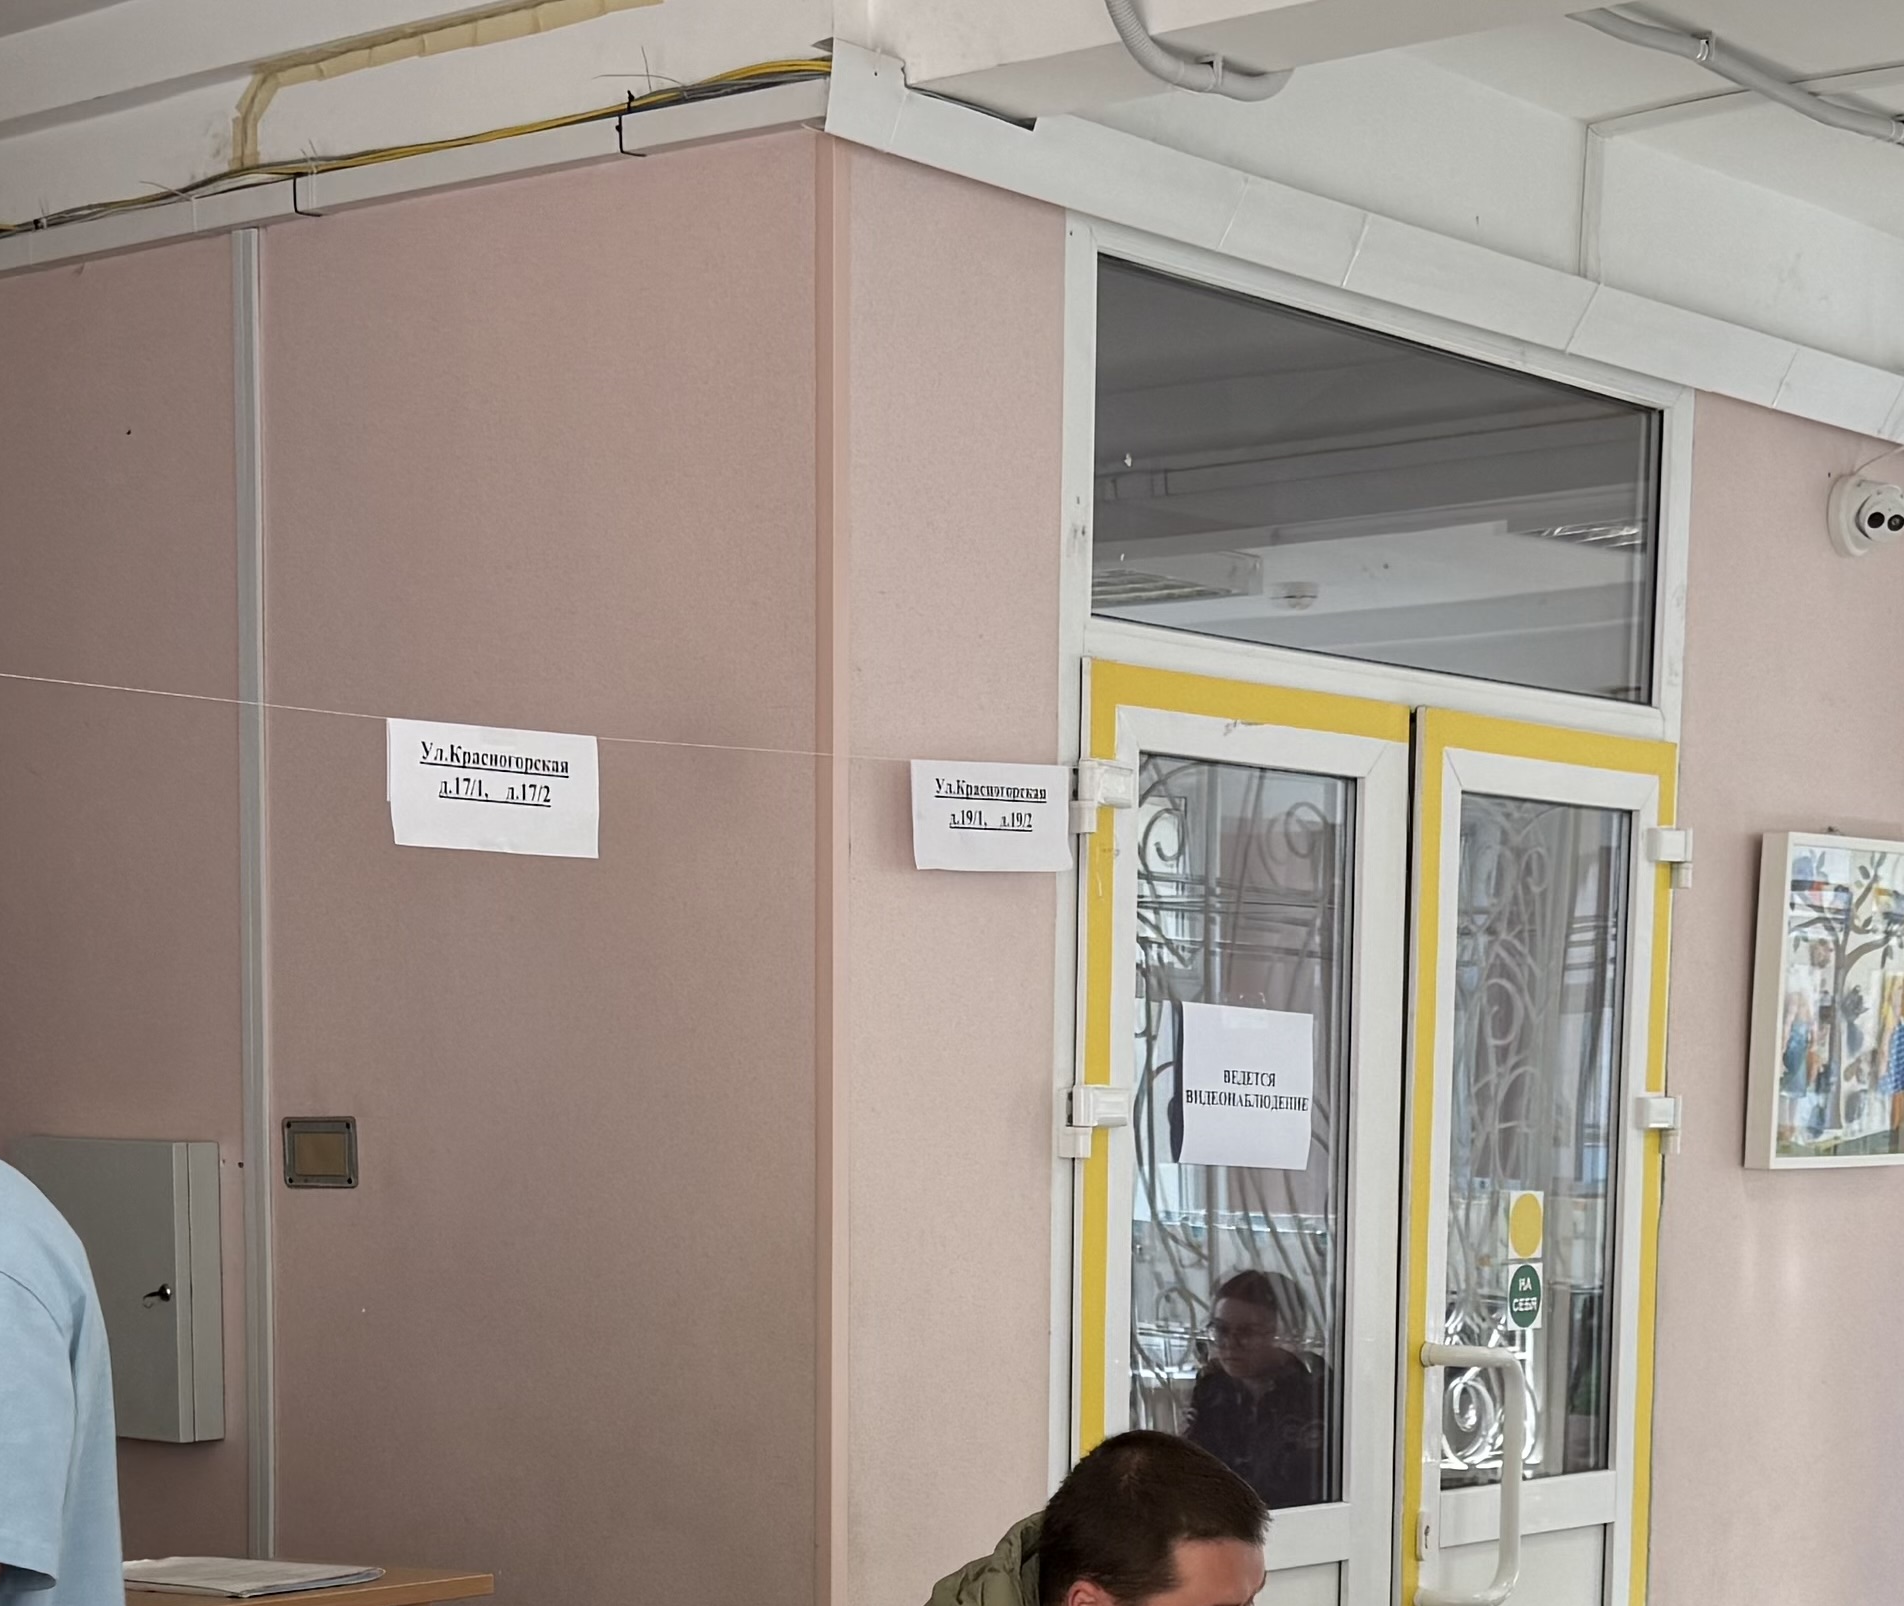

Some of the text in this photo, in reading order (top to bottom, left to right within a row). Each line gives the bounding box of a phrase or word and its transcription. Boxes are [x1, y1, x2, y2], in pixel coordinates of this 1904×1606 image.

[420, 740, 569, 775] Ул.Красногорская
[439, 776, 551, 804] д.17/1, д.17/2
[1000, 812, 1033, 829] д.19/2
[1223, 1069, 1276, 1087] ВЕДЕТСЯ
[1185, 1089, 1309, 1112] ВИДЕОНАБЛЮДЕНИЕ
